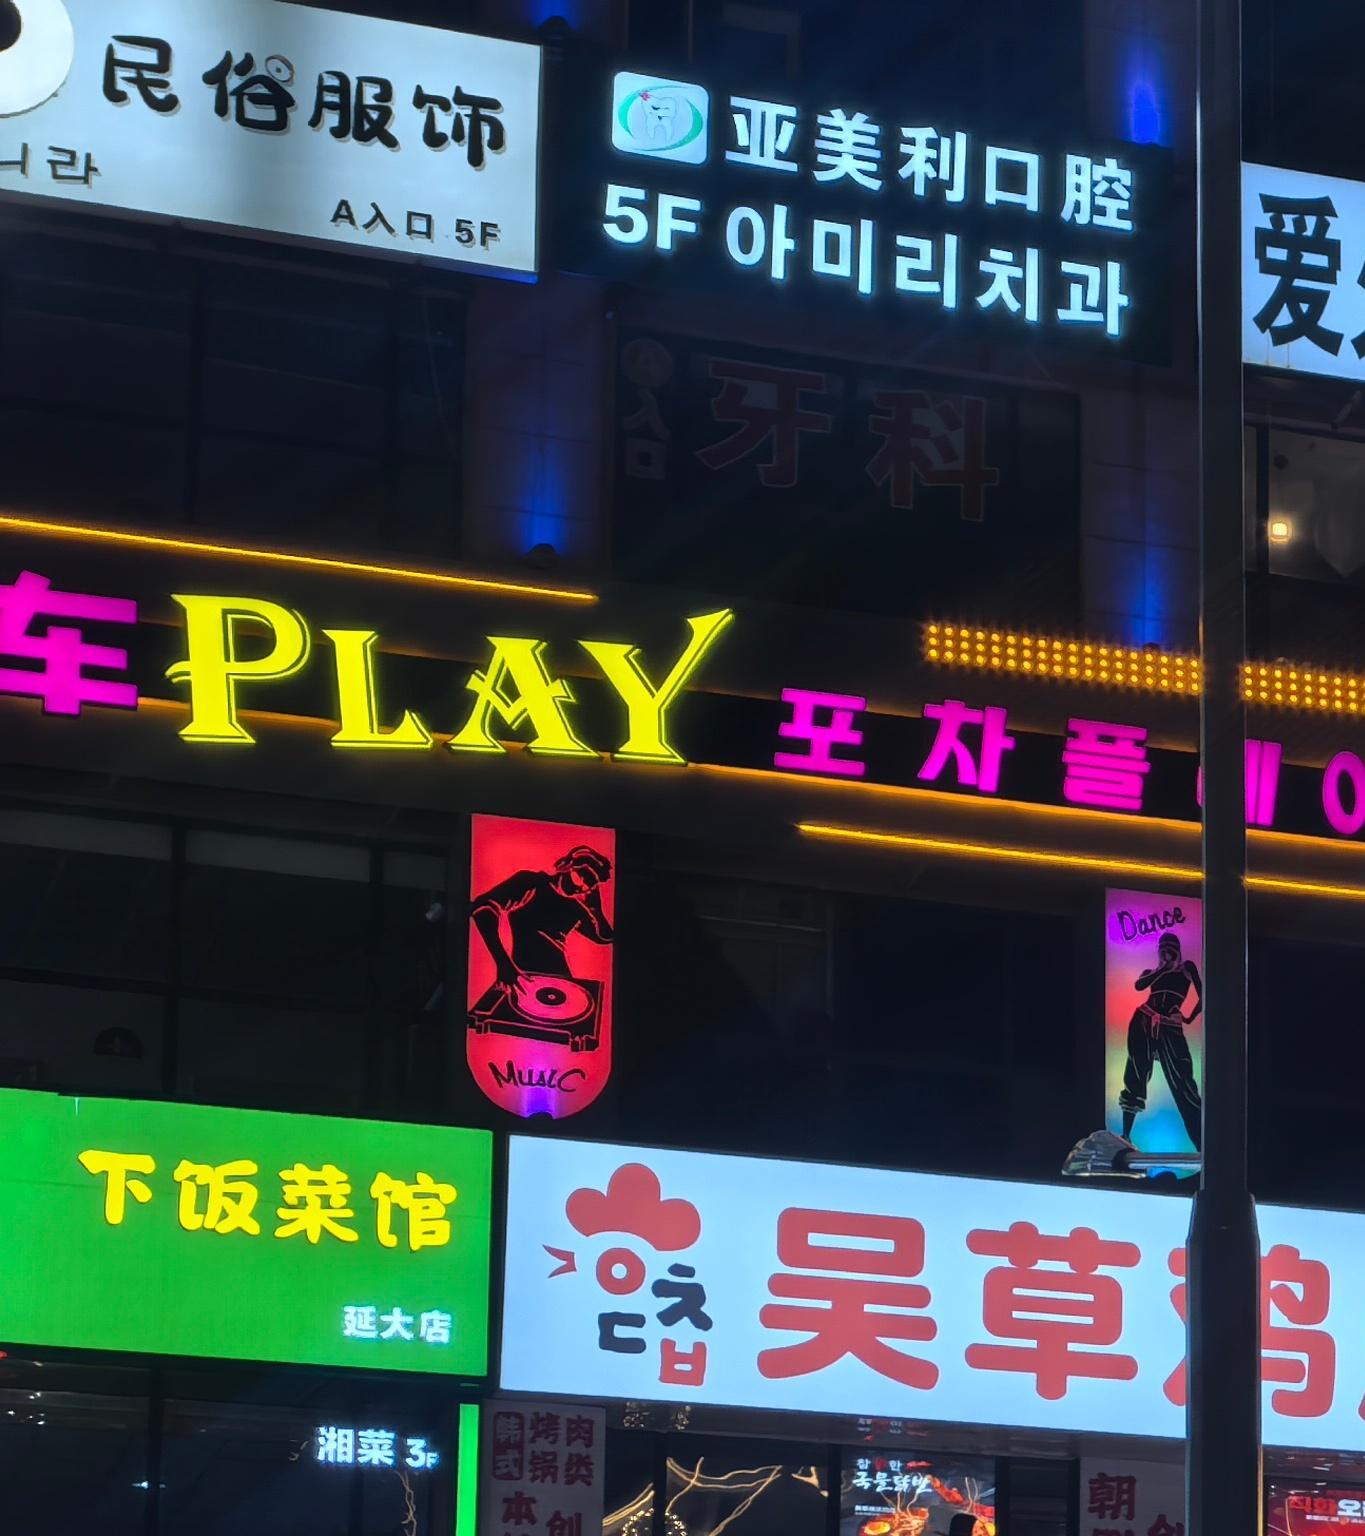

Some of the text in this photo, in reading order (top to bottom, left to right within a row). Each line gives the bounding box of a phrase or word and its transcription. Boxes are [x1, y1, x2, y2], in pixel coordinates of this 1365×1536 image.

[102, 35, 506, 169] 民俗服饰
[724, 96, 1134, 232] 亚美利口腔
[330, 199, 502, 249] A入口 5F
[603, 185, 1130, 339] 5F 아미리치과
[164, 592, 736, 767] PLAY
[1117, 904, 1187, 942] Dance
[77, 1149, 459, 1252] 下饭菜馆
[342, 1305, 452, 1345] 延大店
[316, 1426, 440, 1469] 湘菜 3F
